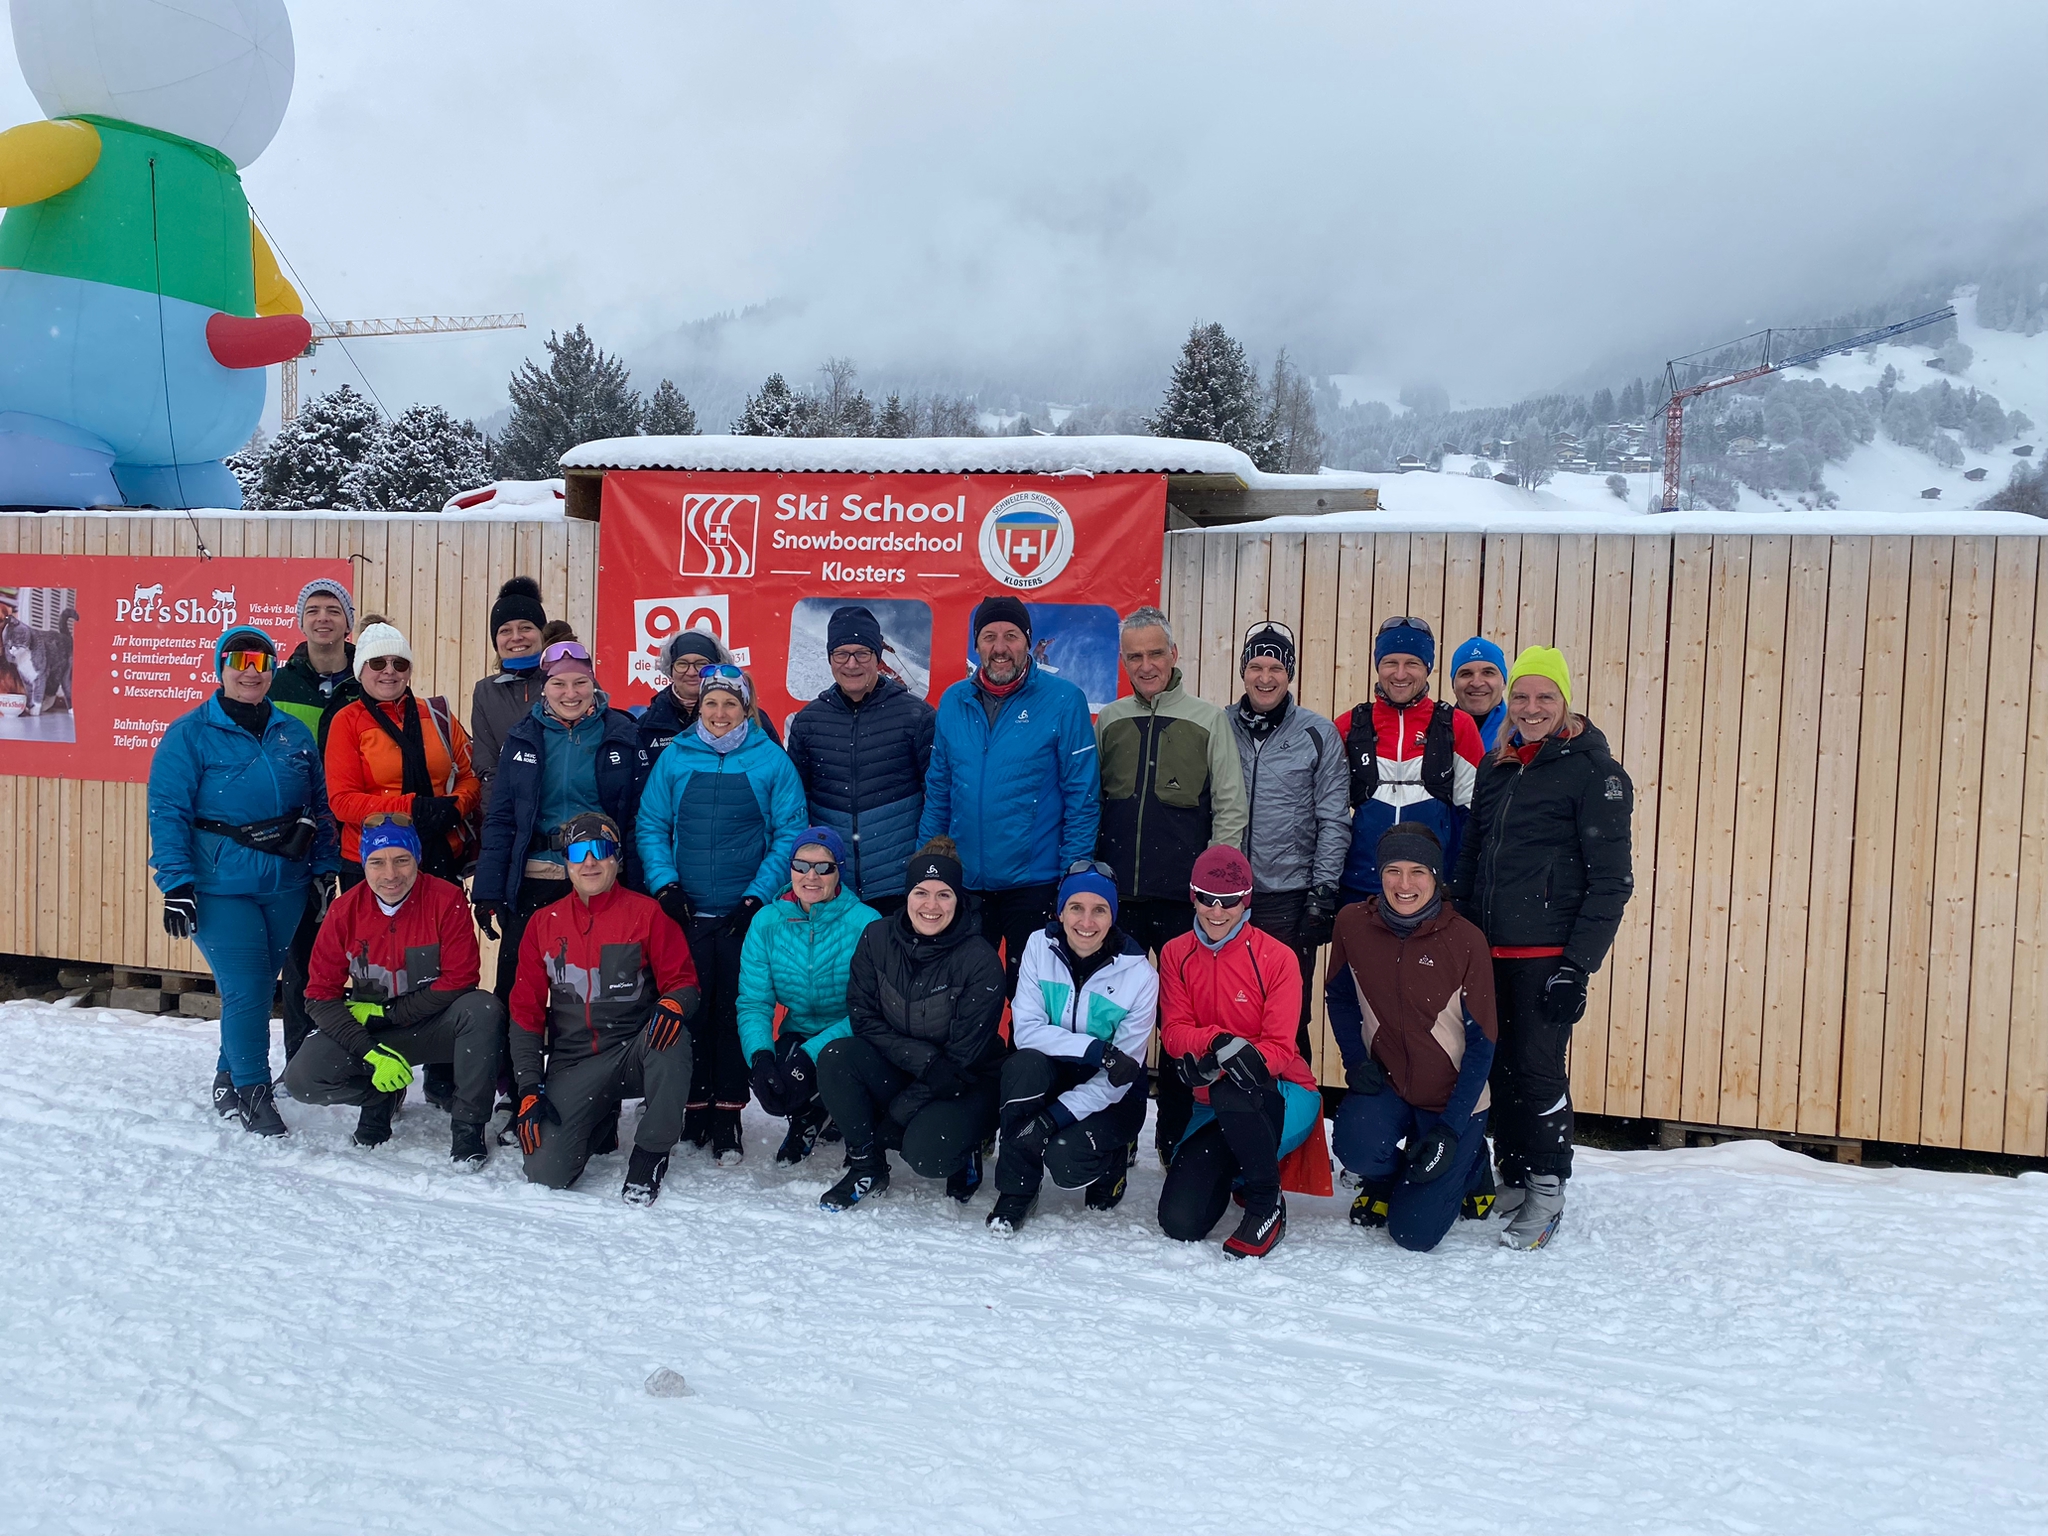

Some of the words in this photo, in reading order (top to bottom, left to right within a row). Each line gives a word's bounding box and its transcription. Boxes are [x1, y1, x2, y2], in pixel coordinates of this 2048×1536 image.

[774, 493, 829, 522] Ski
[840, 494, 966, 523] School
[992, 493, 1028, 516] SCHWEIZER
[1031, 493, 1065, 516] SKISCHULE
[772, 529, 963, 552] Snowboardschool
[821, 561, 906, 583] Klosters
[1003, 575, 1043, 587] KLOSTERS
[115, 598, 172, 622] Pet's
[174, 598, 237, 632] Shop
[249, 604, 283, 614] Vis-à-vis
[248, 616, 273, 626] Davos
[274, 617, 295, 629] Dorf
[112, 635, 127, 646] Ihr
[128, 636, 196, 650] kompetentes
[122, 652, 204, 668] Heimtierbedarf
[634, 661, 651, 671] die
[123, 669, 171, 681] Gravuren
[124, 686, 203, 702] Messerschleifen
[113, 735, 148, 750] Telefon
